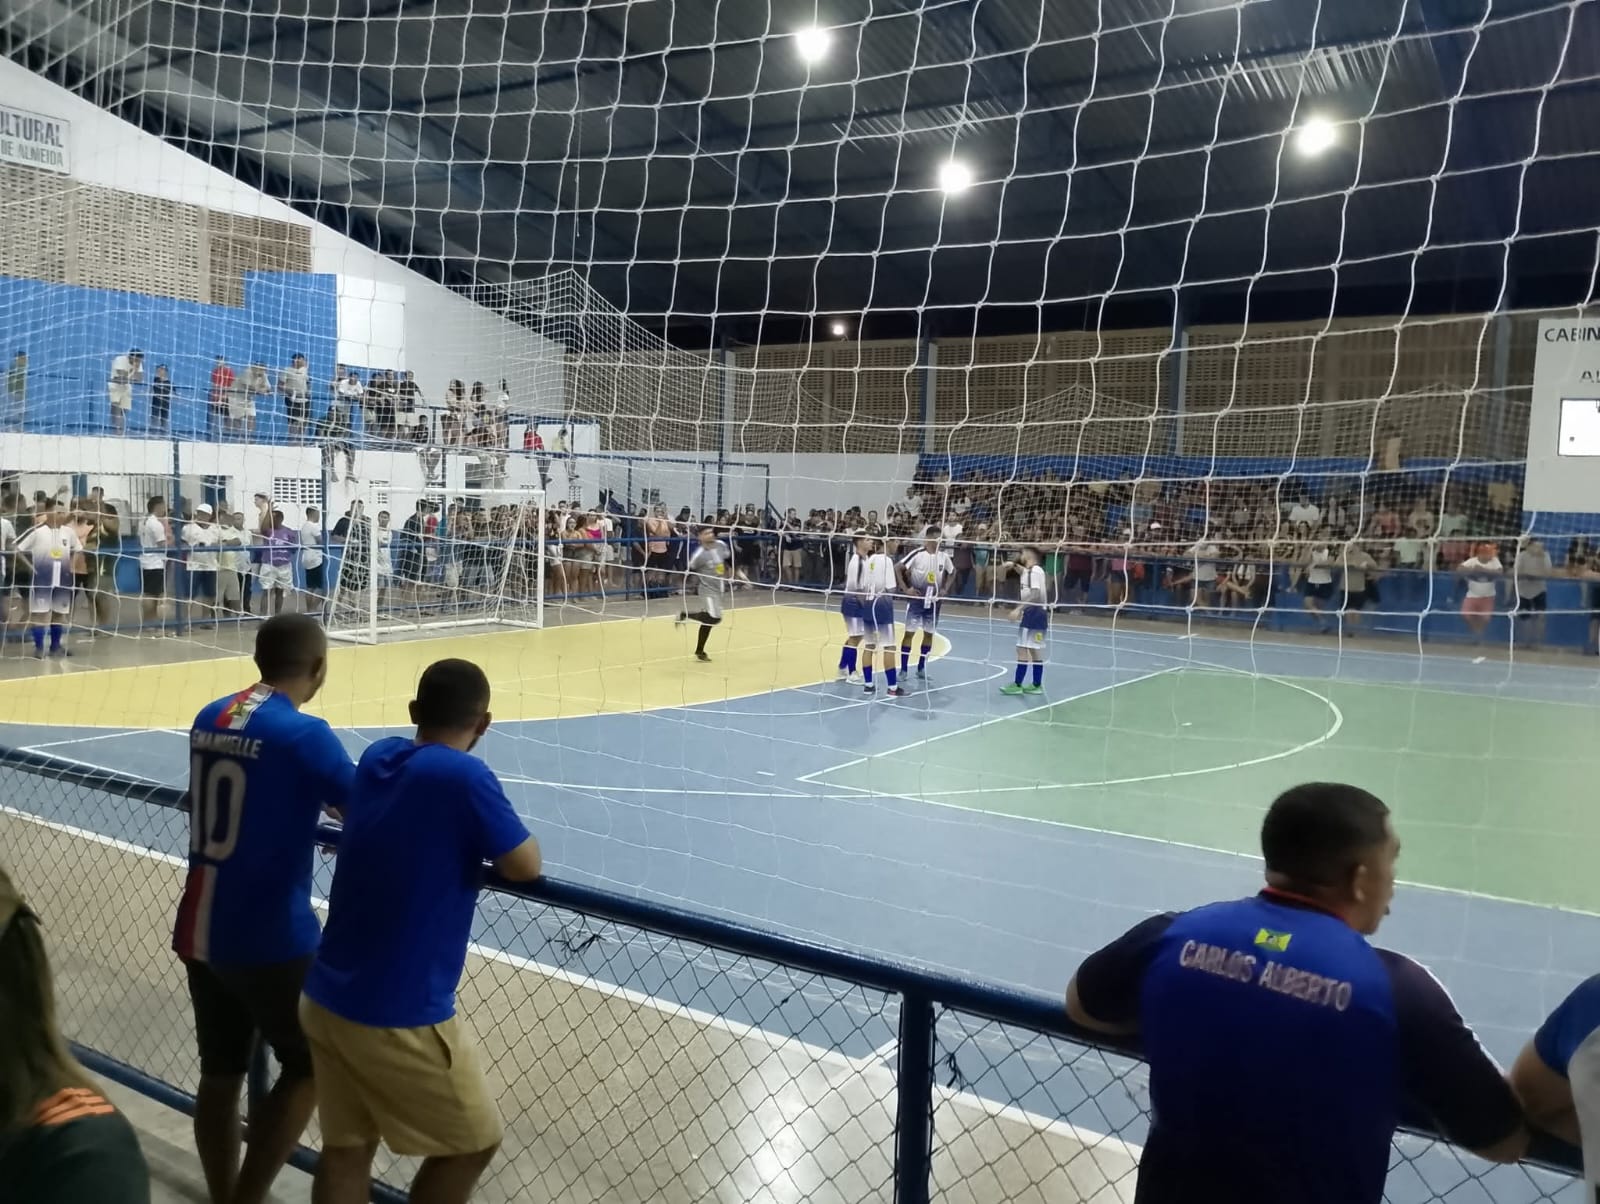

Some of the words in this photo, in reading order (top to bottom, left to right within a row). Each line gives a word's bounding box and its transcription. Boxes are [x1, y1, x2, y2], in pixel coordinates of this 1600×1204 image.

[191, 753, 246, 861] 10
[1179, 939, 1257, 983] CARLOS
[1258, 960, 1353, 1012] ALBERTO
